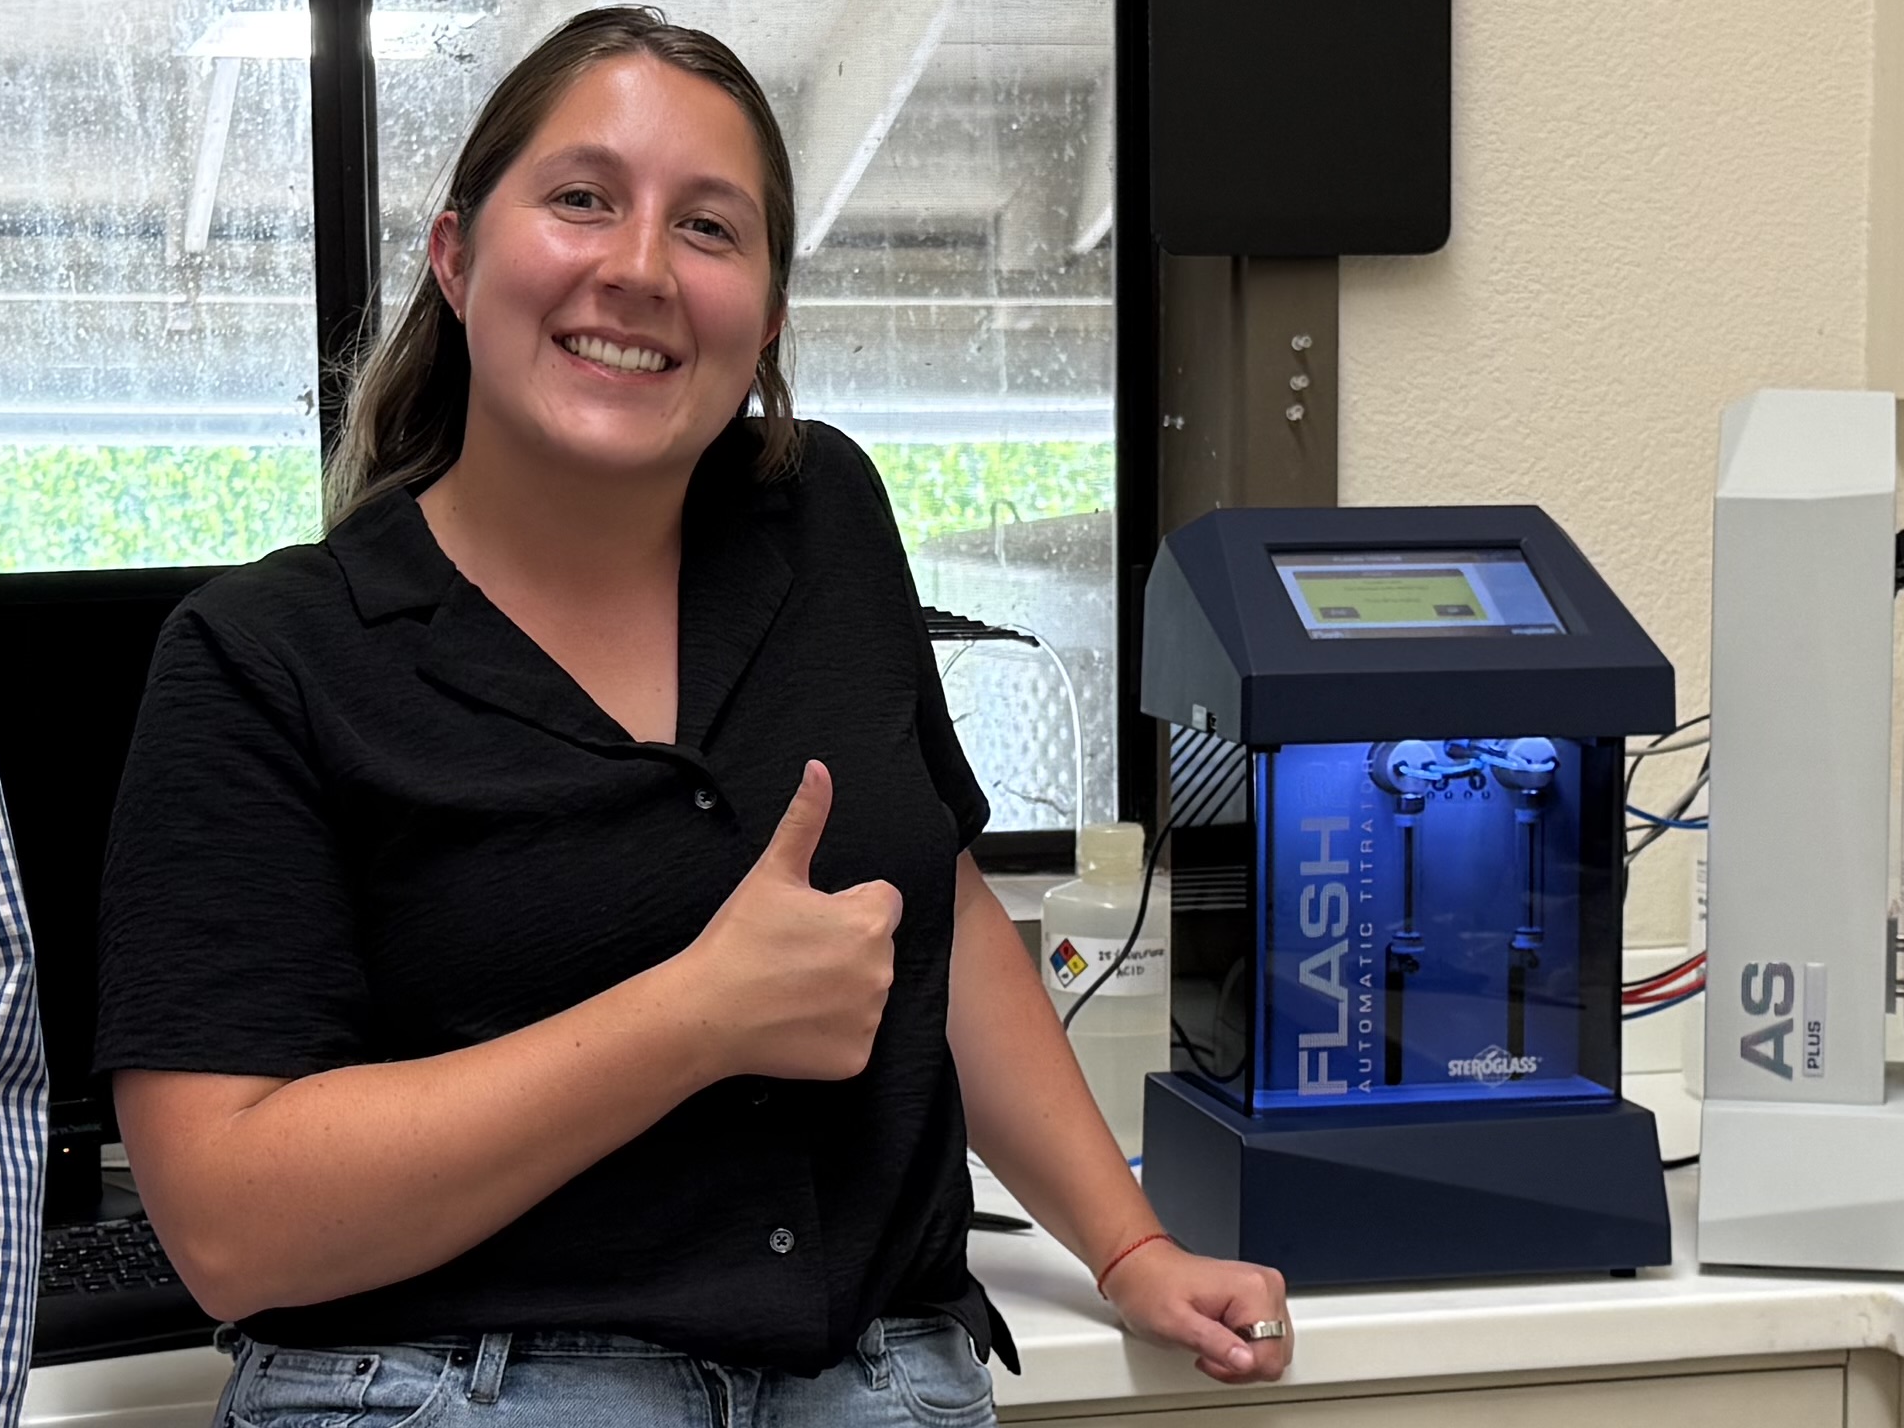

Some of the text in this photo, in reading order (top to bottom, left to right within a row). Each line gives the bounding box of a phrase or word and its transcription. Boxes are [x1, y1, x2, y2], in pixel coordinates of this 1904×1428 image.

[1298, 816, 1350, 1096] FLASH
[1358, 758, 1374, 1093] AUTOMATIC TITRATOR
[1116, 966, 1145, 978] ACID
[1740, 961, 1795, 1081] AS
[1807, 1020, 1821, 1070] PLUS
[1448, 1051, 1539, 1080] STEROGLASS
